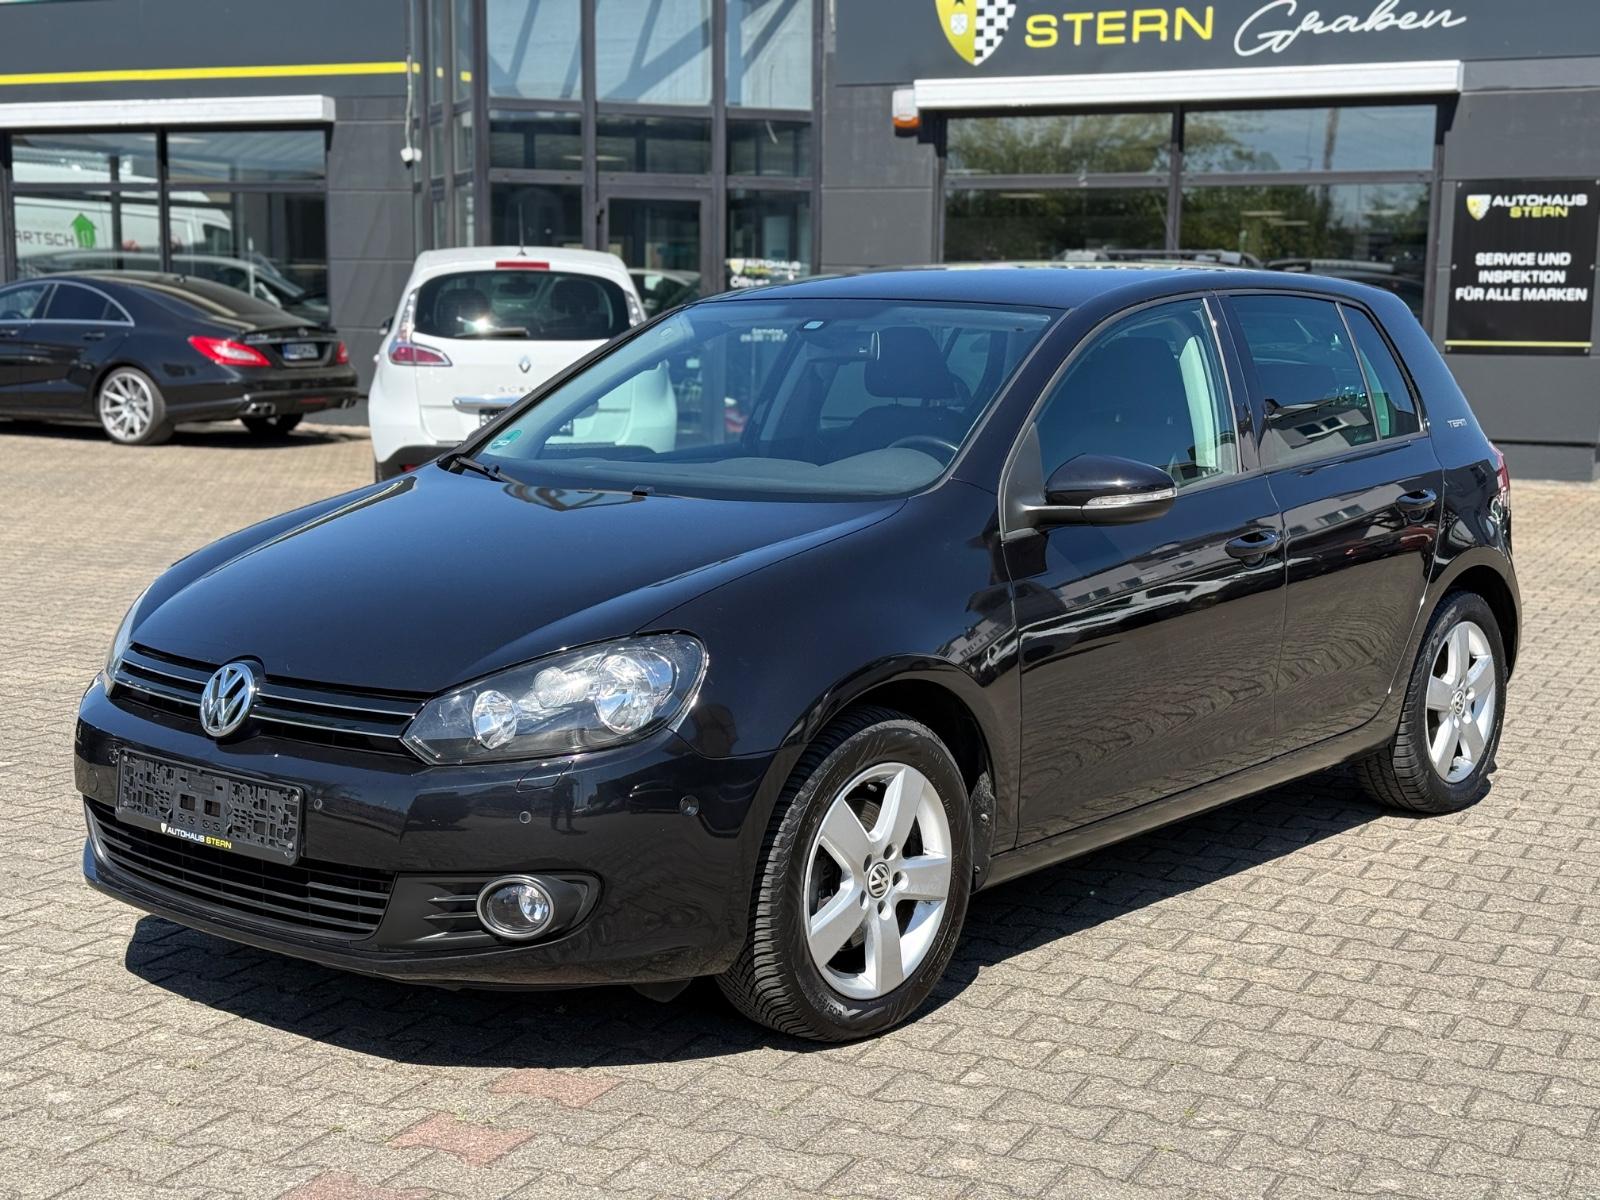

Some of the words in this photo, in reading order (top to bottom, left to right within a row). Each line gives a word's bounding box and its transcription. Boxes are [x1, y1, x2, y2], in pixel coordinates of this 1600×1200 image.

[1025, 6, 1213, 48] STERN
[1234, 0, 1467, 56] Graben
[1492, 194, 1588, 206] AUTOHAUS
[1510, 206, 1568, 218] STERN
[1475, 252, 1536, 266] SERVICE
[1537, 252, 1572, 266] UND
[1478, 270, 1566, 284] INSPEKTION
[1455, 285, 1485, 301] FÜR
[1486, 287, 1521, 301] ALLE
[1522, 287, 1588, 302] MARKEN
[167, 826, 205, 843] AUTOHAUS
[205, 836, 232, 849] STERN
